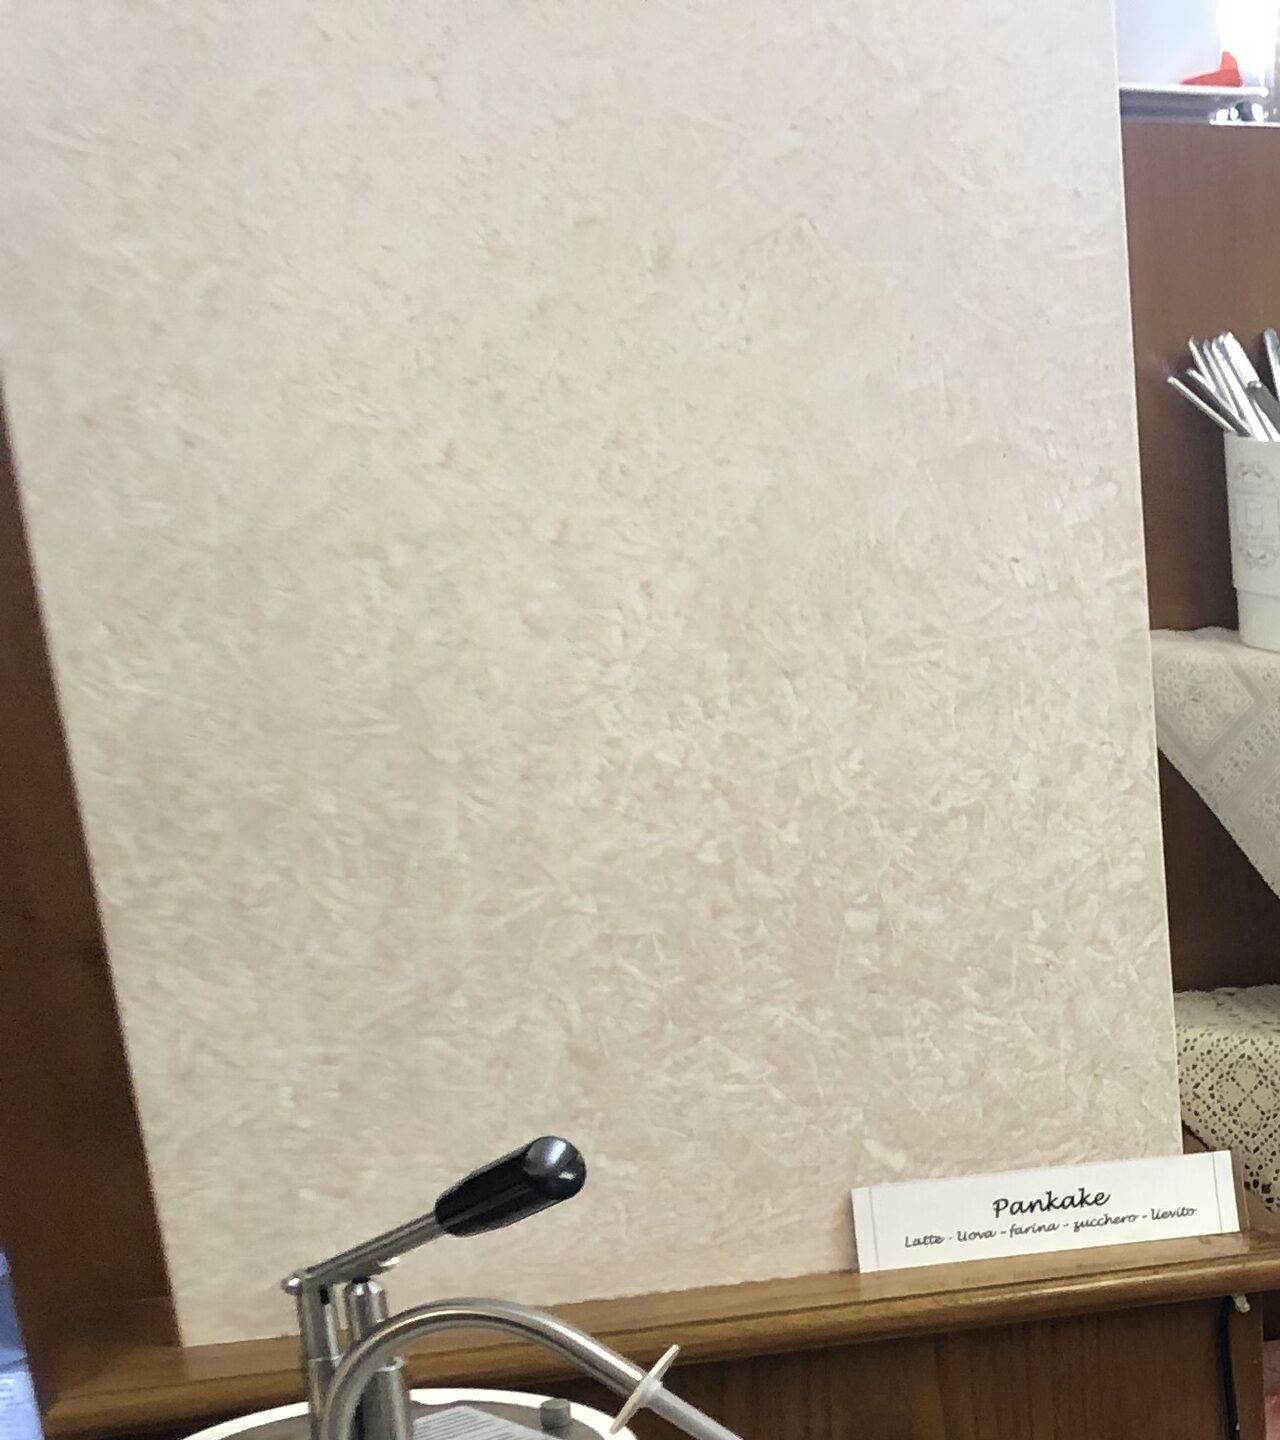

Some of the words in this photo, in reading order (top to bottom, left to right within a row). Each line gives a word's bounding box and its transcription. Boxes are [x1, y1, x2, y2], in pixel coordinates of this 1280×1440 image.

[992, 1188, 1111, 1218] Pankake
[904, 1235, 945, 1248] Latte
[1009, 1222, 1060, 1239] farina
[1073, 1213, 1140, 1233] zucchero
